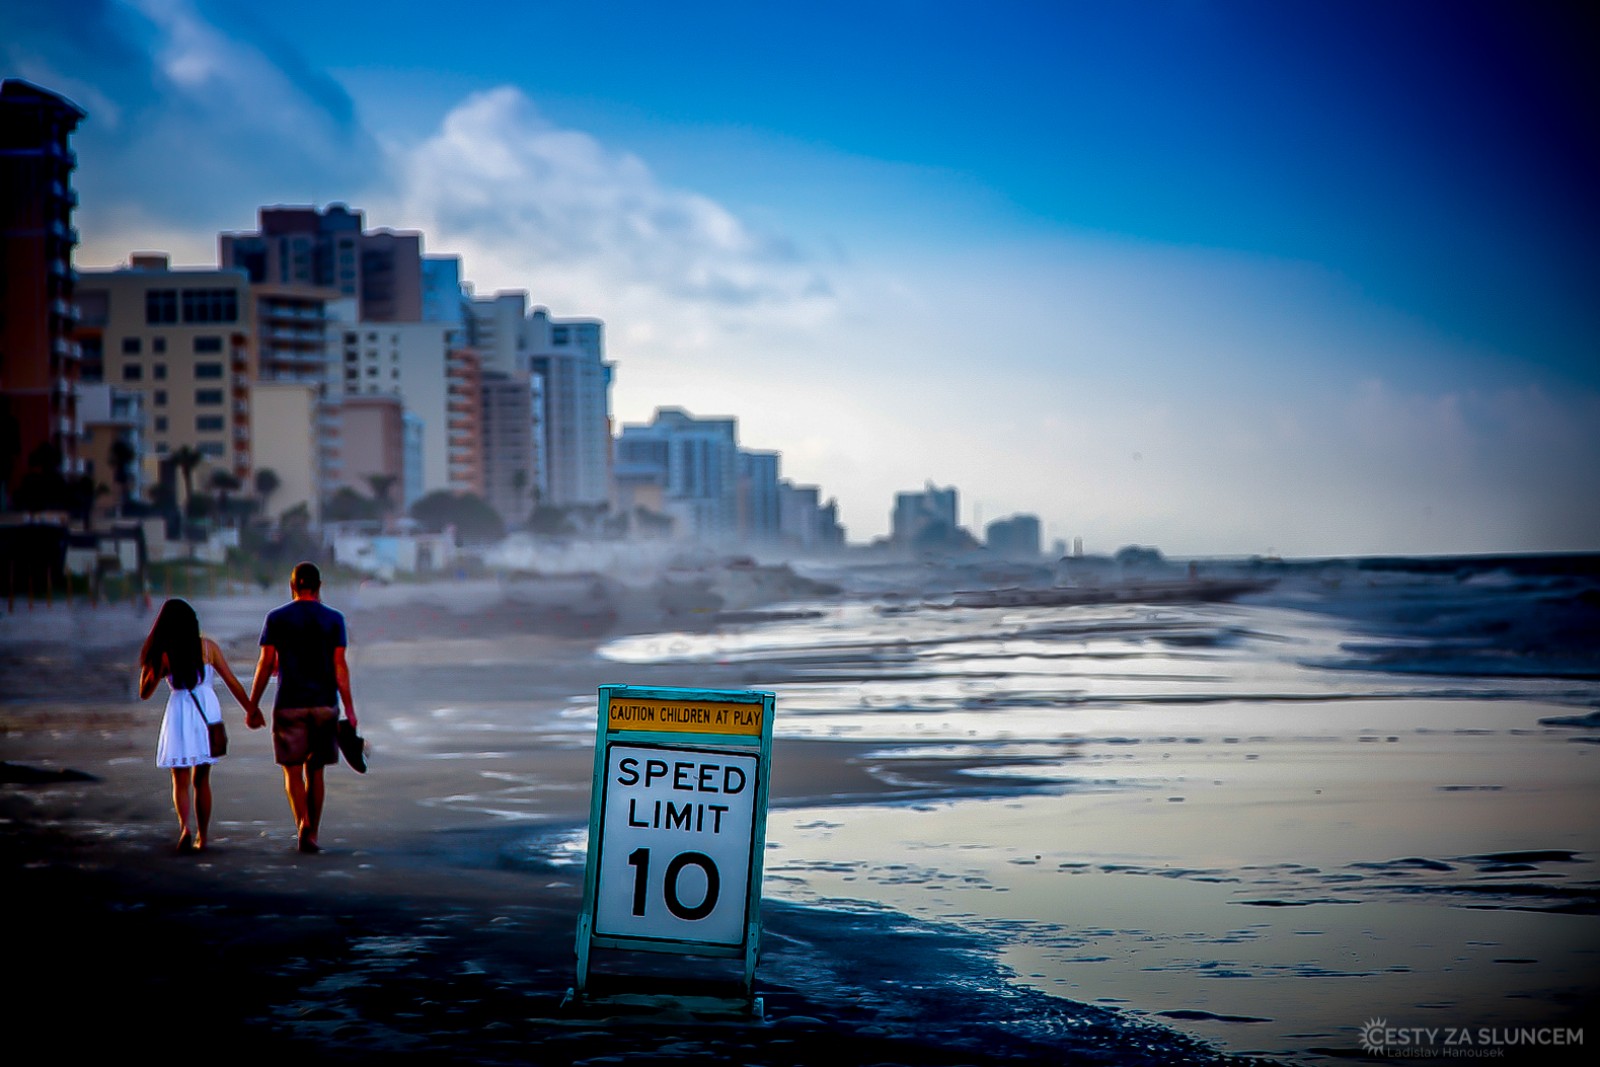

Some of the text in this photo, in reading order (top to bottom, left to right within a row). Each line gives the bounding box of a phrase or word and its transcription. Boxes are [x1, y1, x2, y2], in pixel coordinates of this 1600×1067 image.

[610, 704, 761, 726] CAUTION CHILDREN AT PLAY
[616, 757, 746, 795] SPEED
[628, 798, 729, 834] LIMIT
[628, 847, 720, 921] 10
